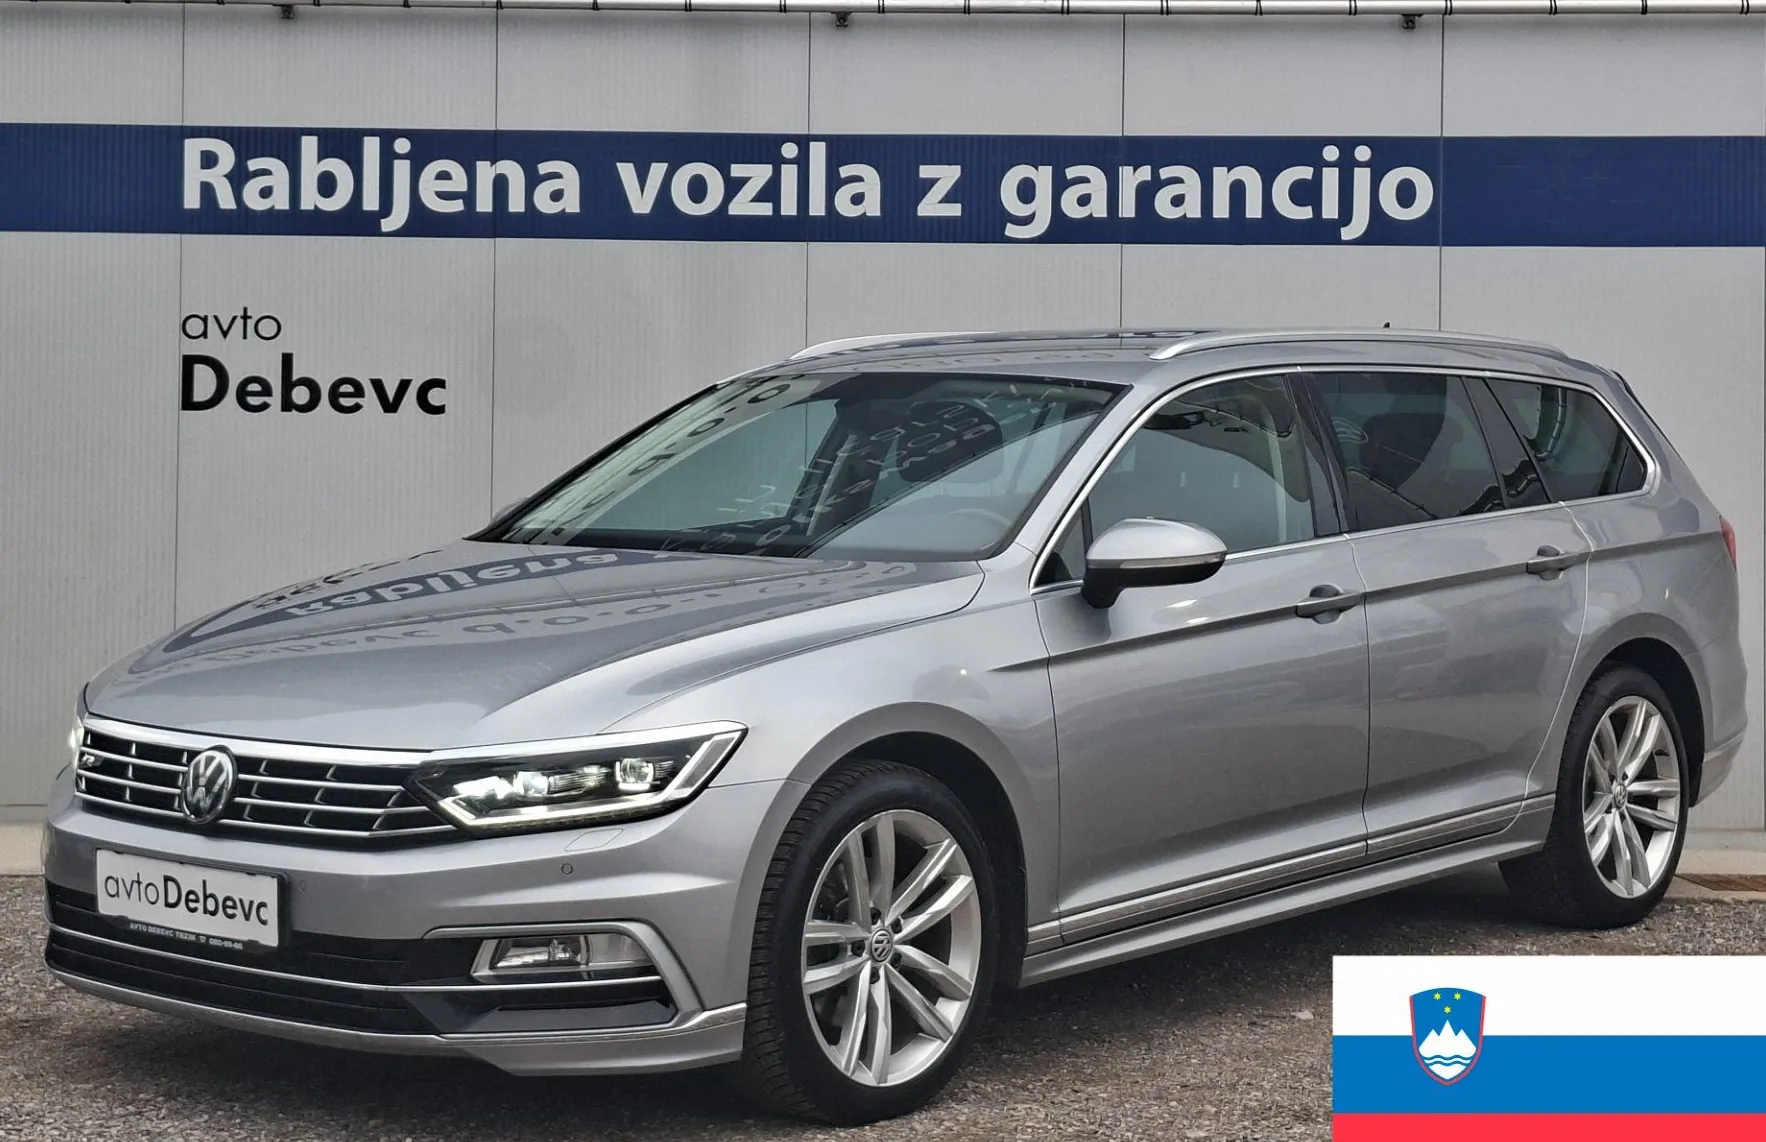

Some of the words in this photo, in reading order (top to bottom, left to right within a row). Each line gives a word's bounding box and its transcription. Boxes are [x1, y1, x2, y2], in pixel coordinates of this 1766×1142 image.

[182, 135, 581, 233] Rabljena
[616, 141, 882, 218] vozila
[917, 164, 963, 218] z
[1000, 144, 1434, 241] garancijo
[181, 306, 282, 341] avto
[180, 352, 447, 416] Debevc
[104, 872, 269, 926] avtoDebevc
